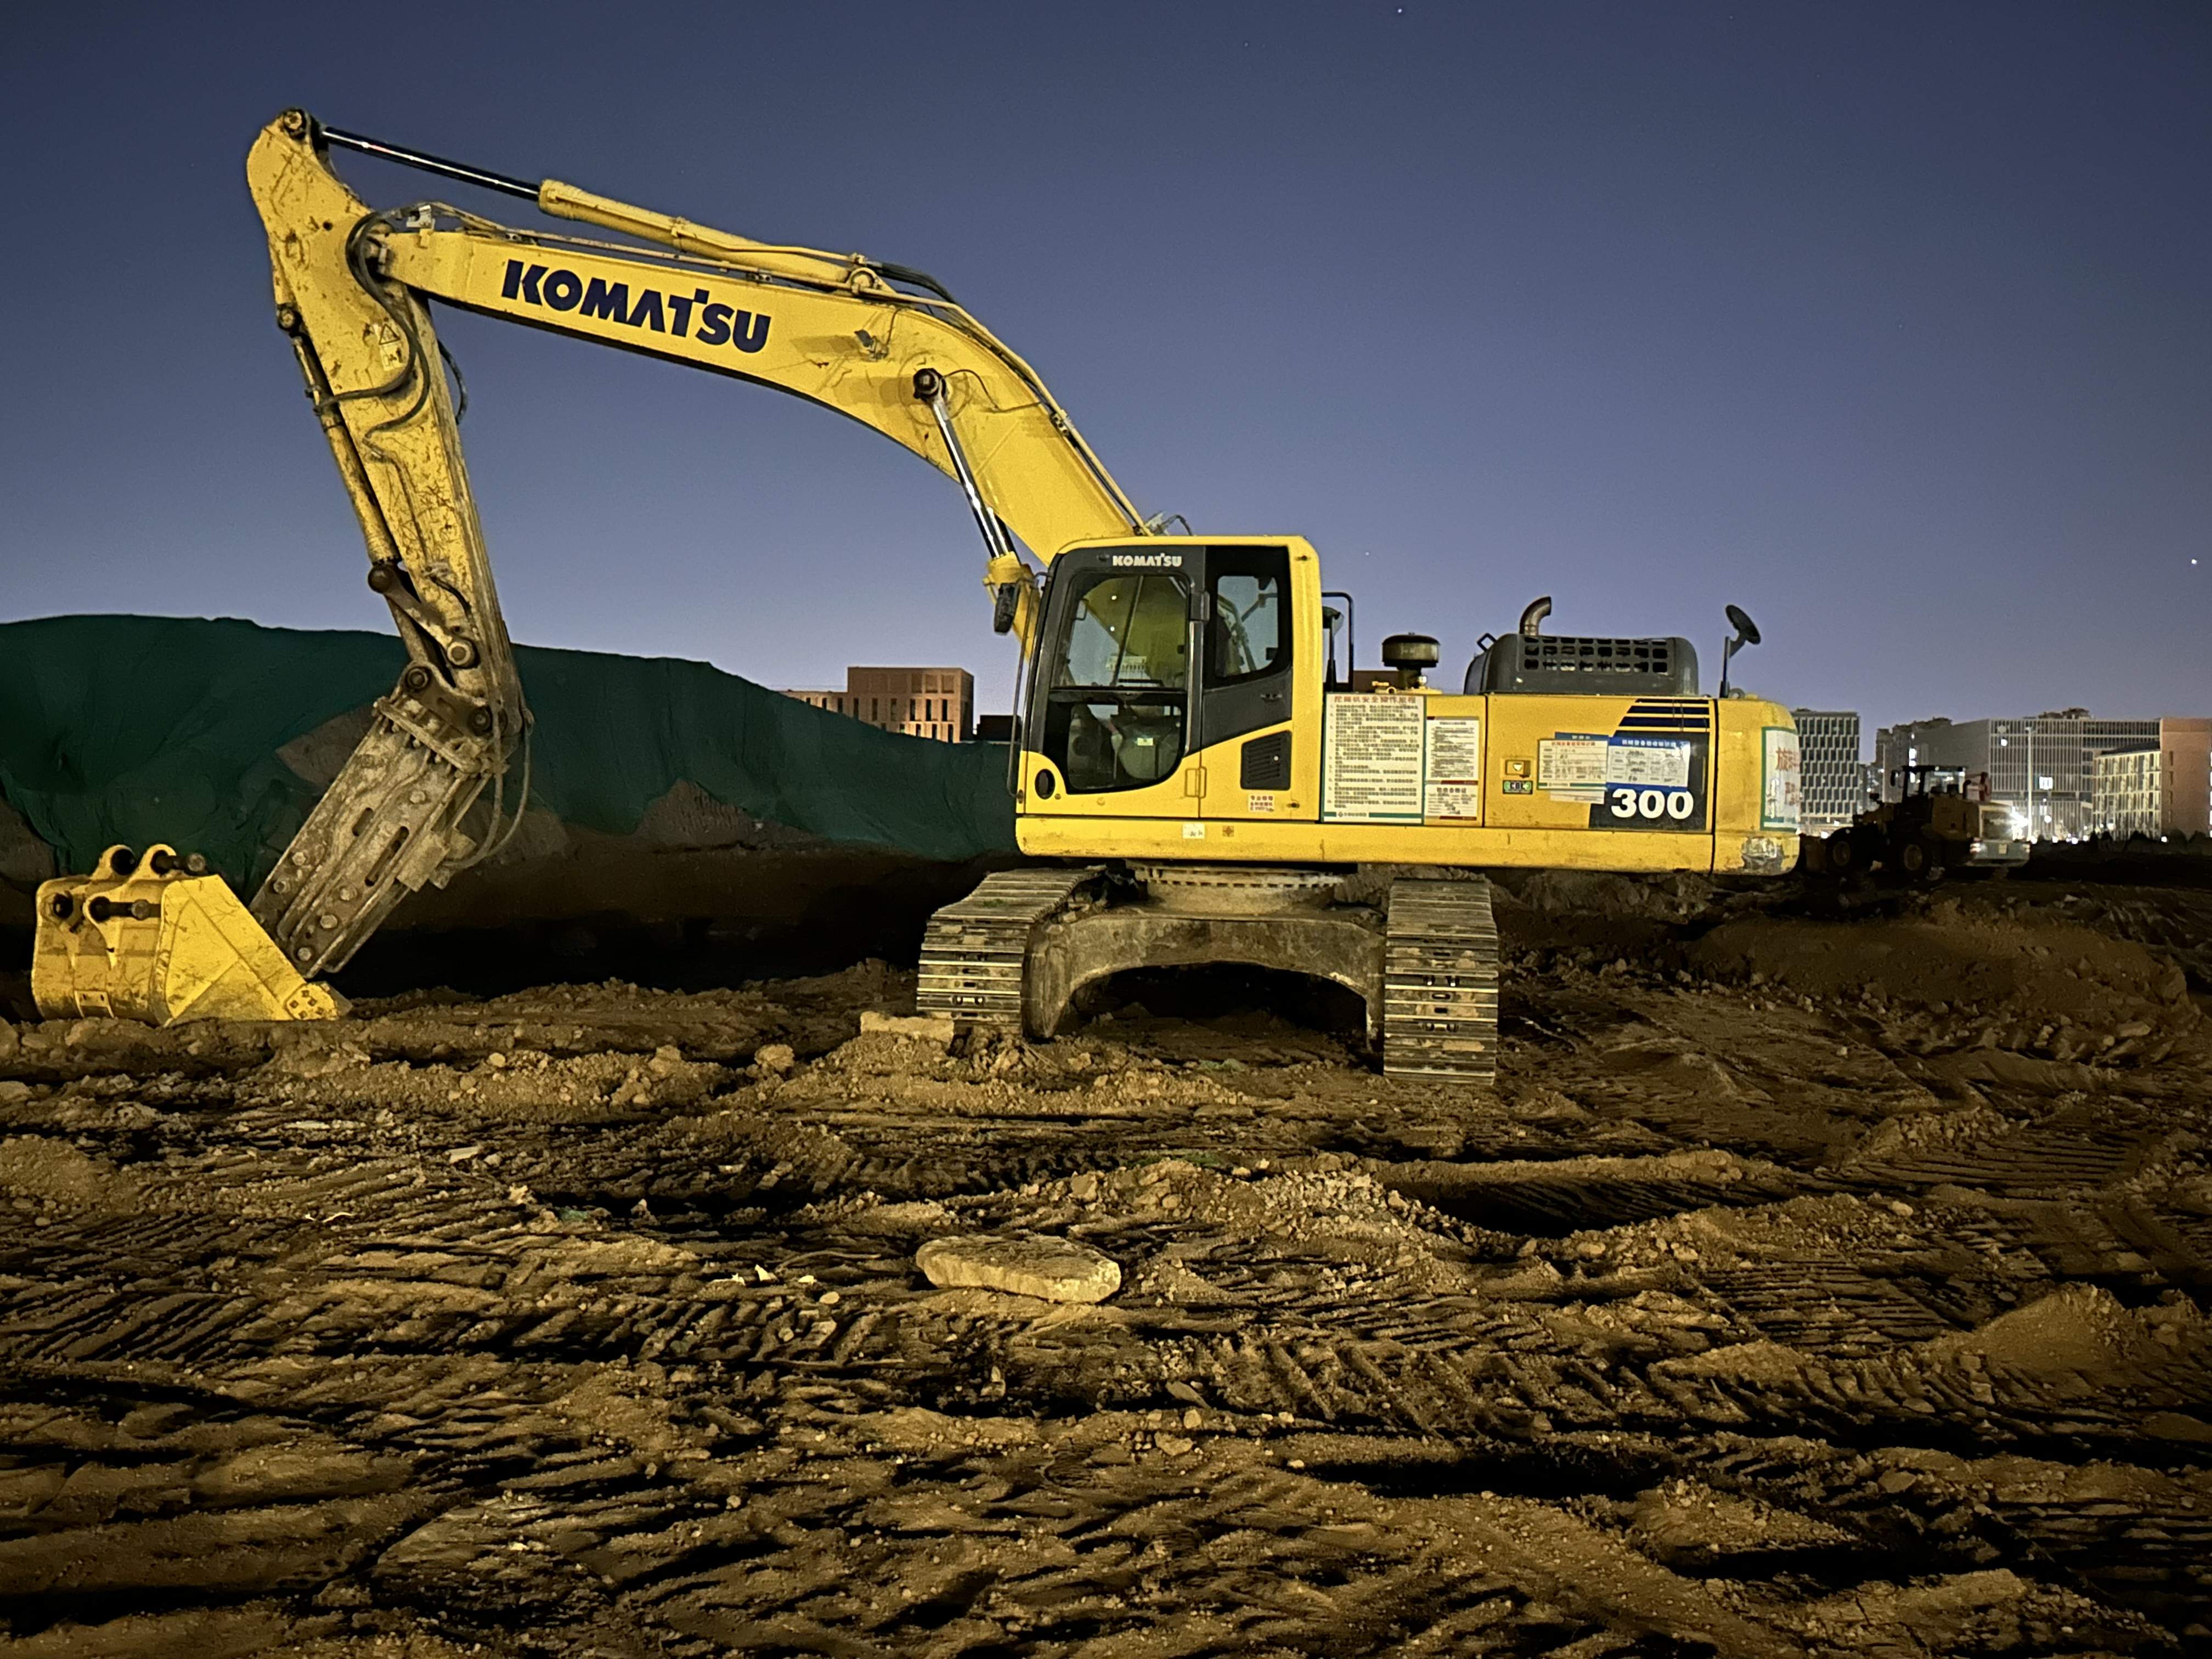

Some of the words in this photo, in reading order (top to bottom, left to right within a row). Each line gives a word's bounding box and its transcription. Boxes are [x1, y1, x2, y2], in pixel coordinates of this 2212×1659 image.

[501, 259, 771, 353] KOMATSU
[1113, 552, 1182, 567] KOMATSU
[1611, 788, 1694, 820] 300
